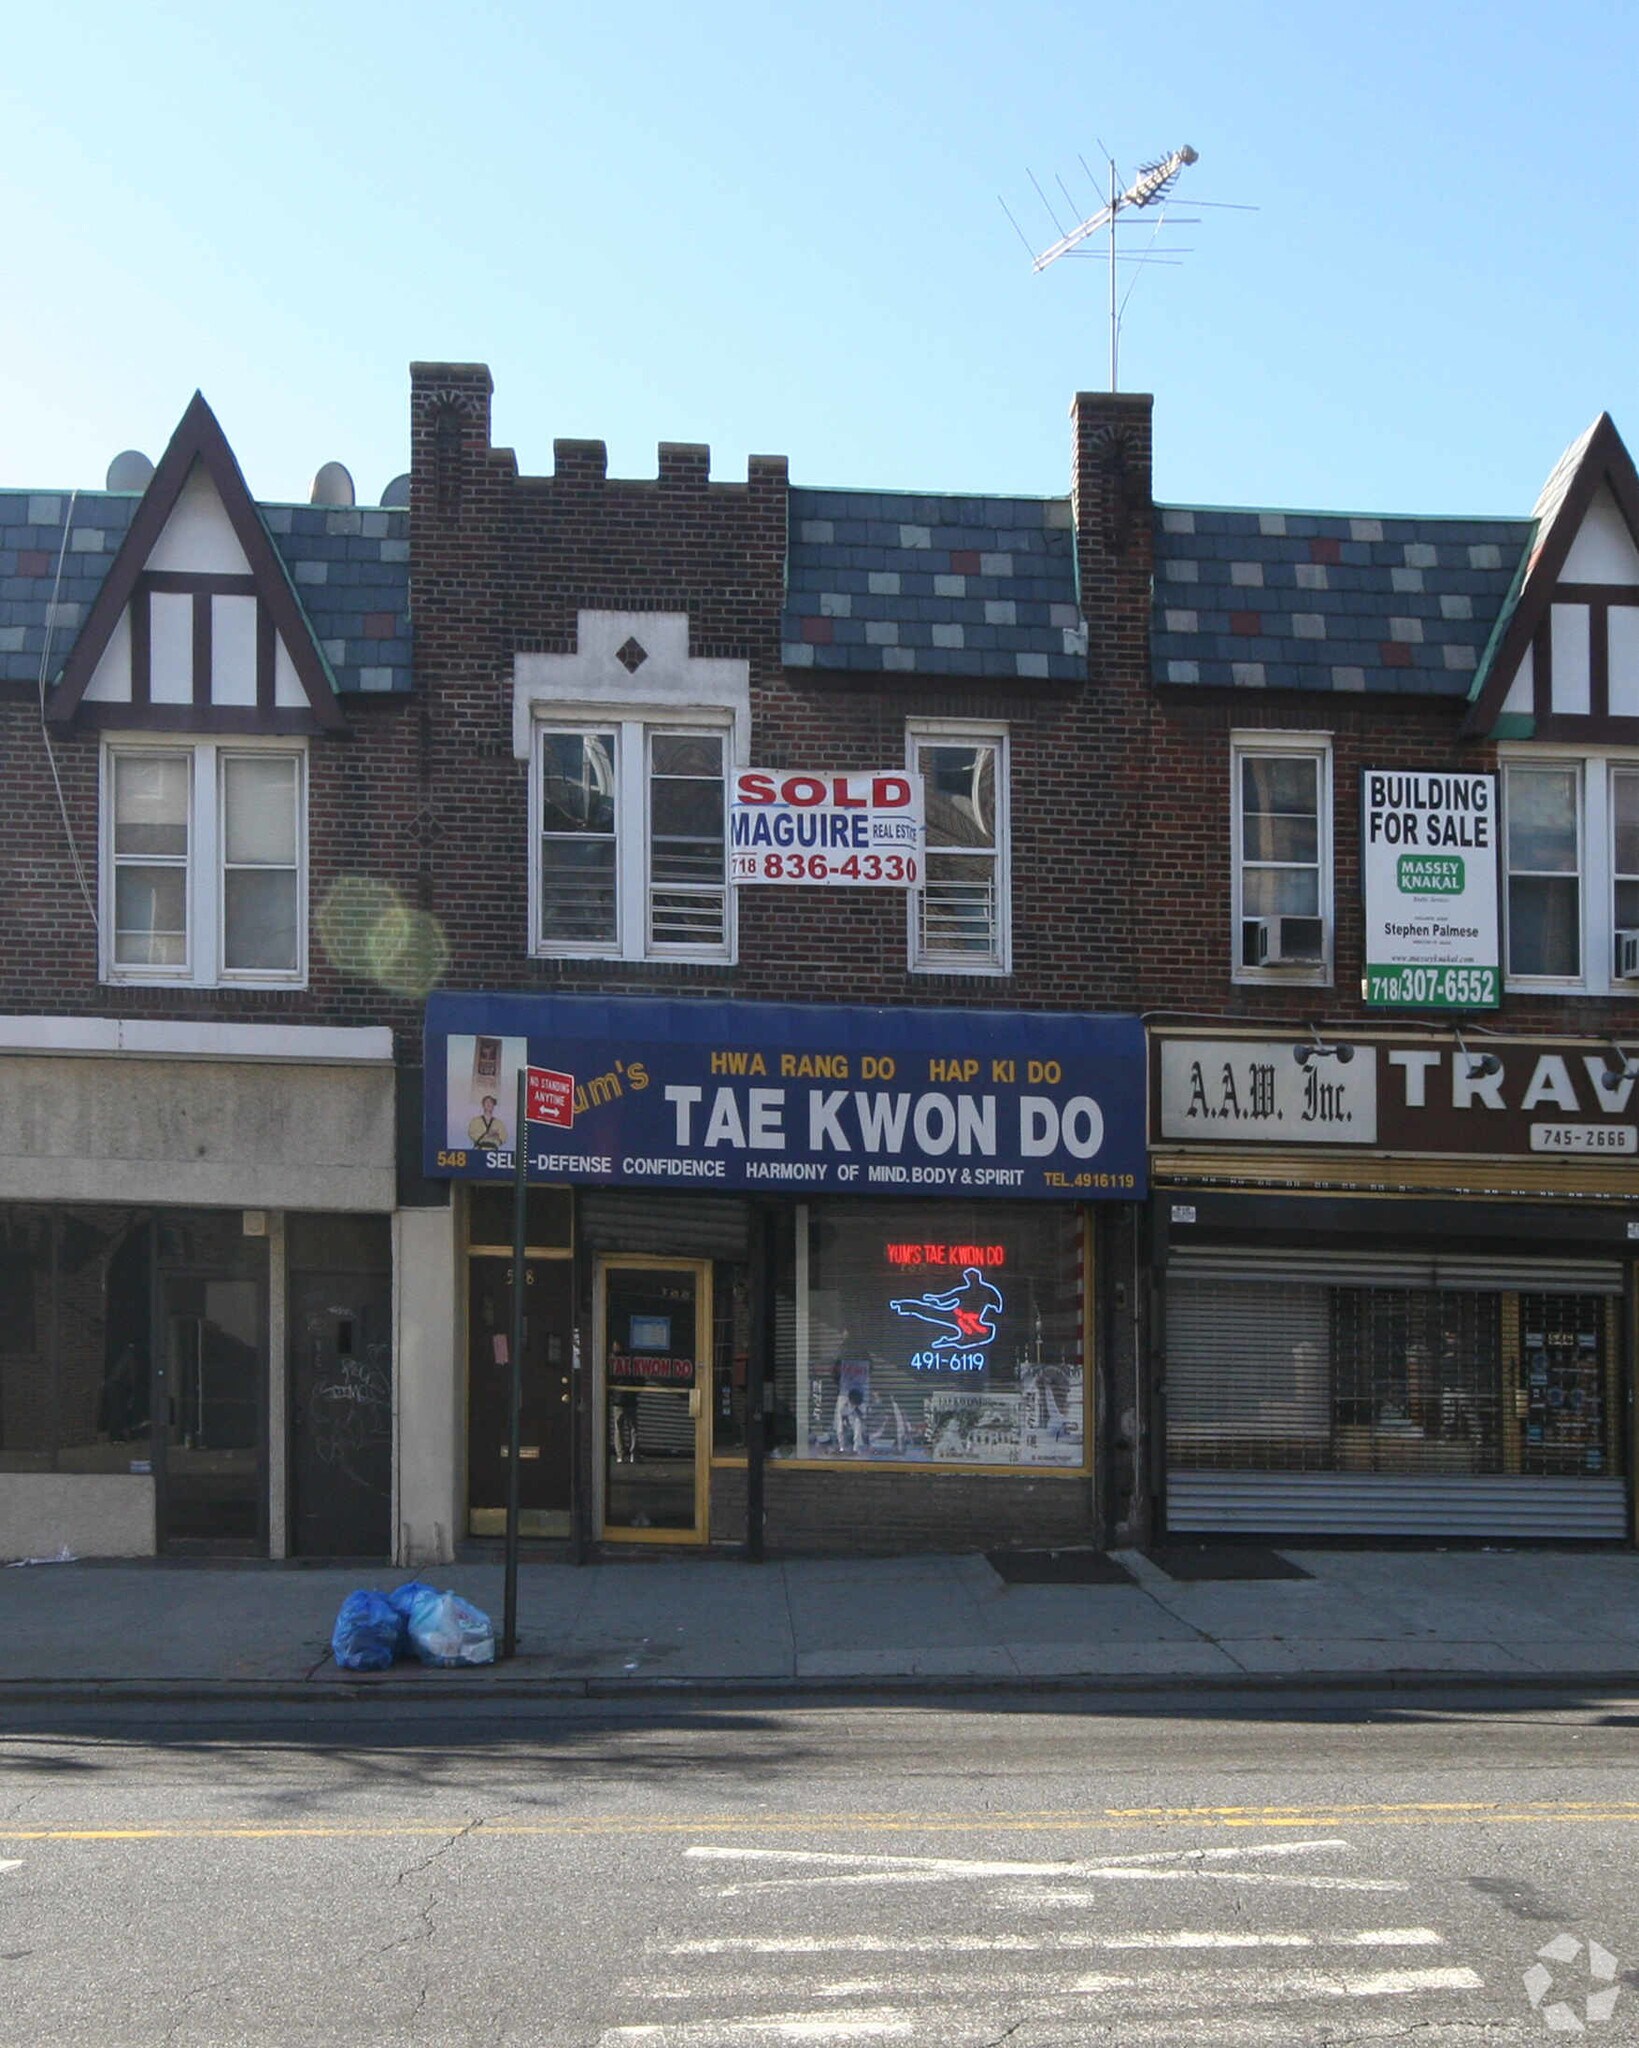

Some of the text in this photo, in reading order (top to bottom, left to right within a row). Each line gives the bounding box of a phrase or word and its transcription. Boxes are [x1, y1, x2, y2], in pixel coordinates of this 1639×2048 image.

[737, 774, 911, 808] SOLD
[1371, 776, 1487, 812] BUILDING
[731, 813, 869, 848] MAGUIRE
[873, 824, 893, 838] REAL
[1370, 812, 1488, 848] FOR SALE
[732, 853, 916, 882] 718 836-4330
[1401, 861, 1459, 875] MASSEY
[1401, 875, 1460, 890] KNAKAL
[1384, 922, 1479, 938] Stephen Palmese
[711, 1052, 1062, 1084] HWA RANG DO HAP KI DO
[530, 1076, 570, 1094] NO STANDING
[1301, 1062, 1352, 1122] Inc.
[534, 1091, 565, 1107] ANYTIME
[664, 1085, 1104, 1159] TAE KWON DO
[1543, 1130, 1627, 1147] 745-2666
[437, 1152, 467, 1167] 548
[486, 1152, 612, 1173] SEL-DEFENSE
[623, 1157, 726, 1178] CONFIDENCE
[746, 1161, 828, 1182] HARMONY
[837, 1164, 859, 1182] OF
[887, 1243, 1004, 1266] YUM'S TAE KWON DO
[633, 1356, 672, 1377] KWON
[673, 1358, 694, 1378] DO
[911, 1352, 985, 1372] 491-6119
